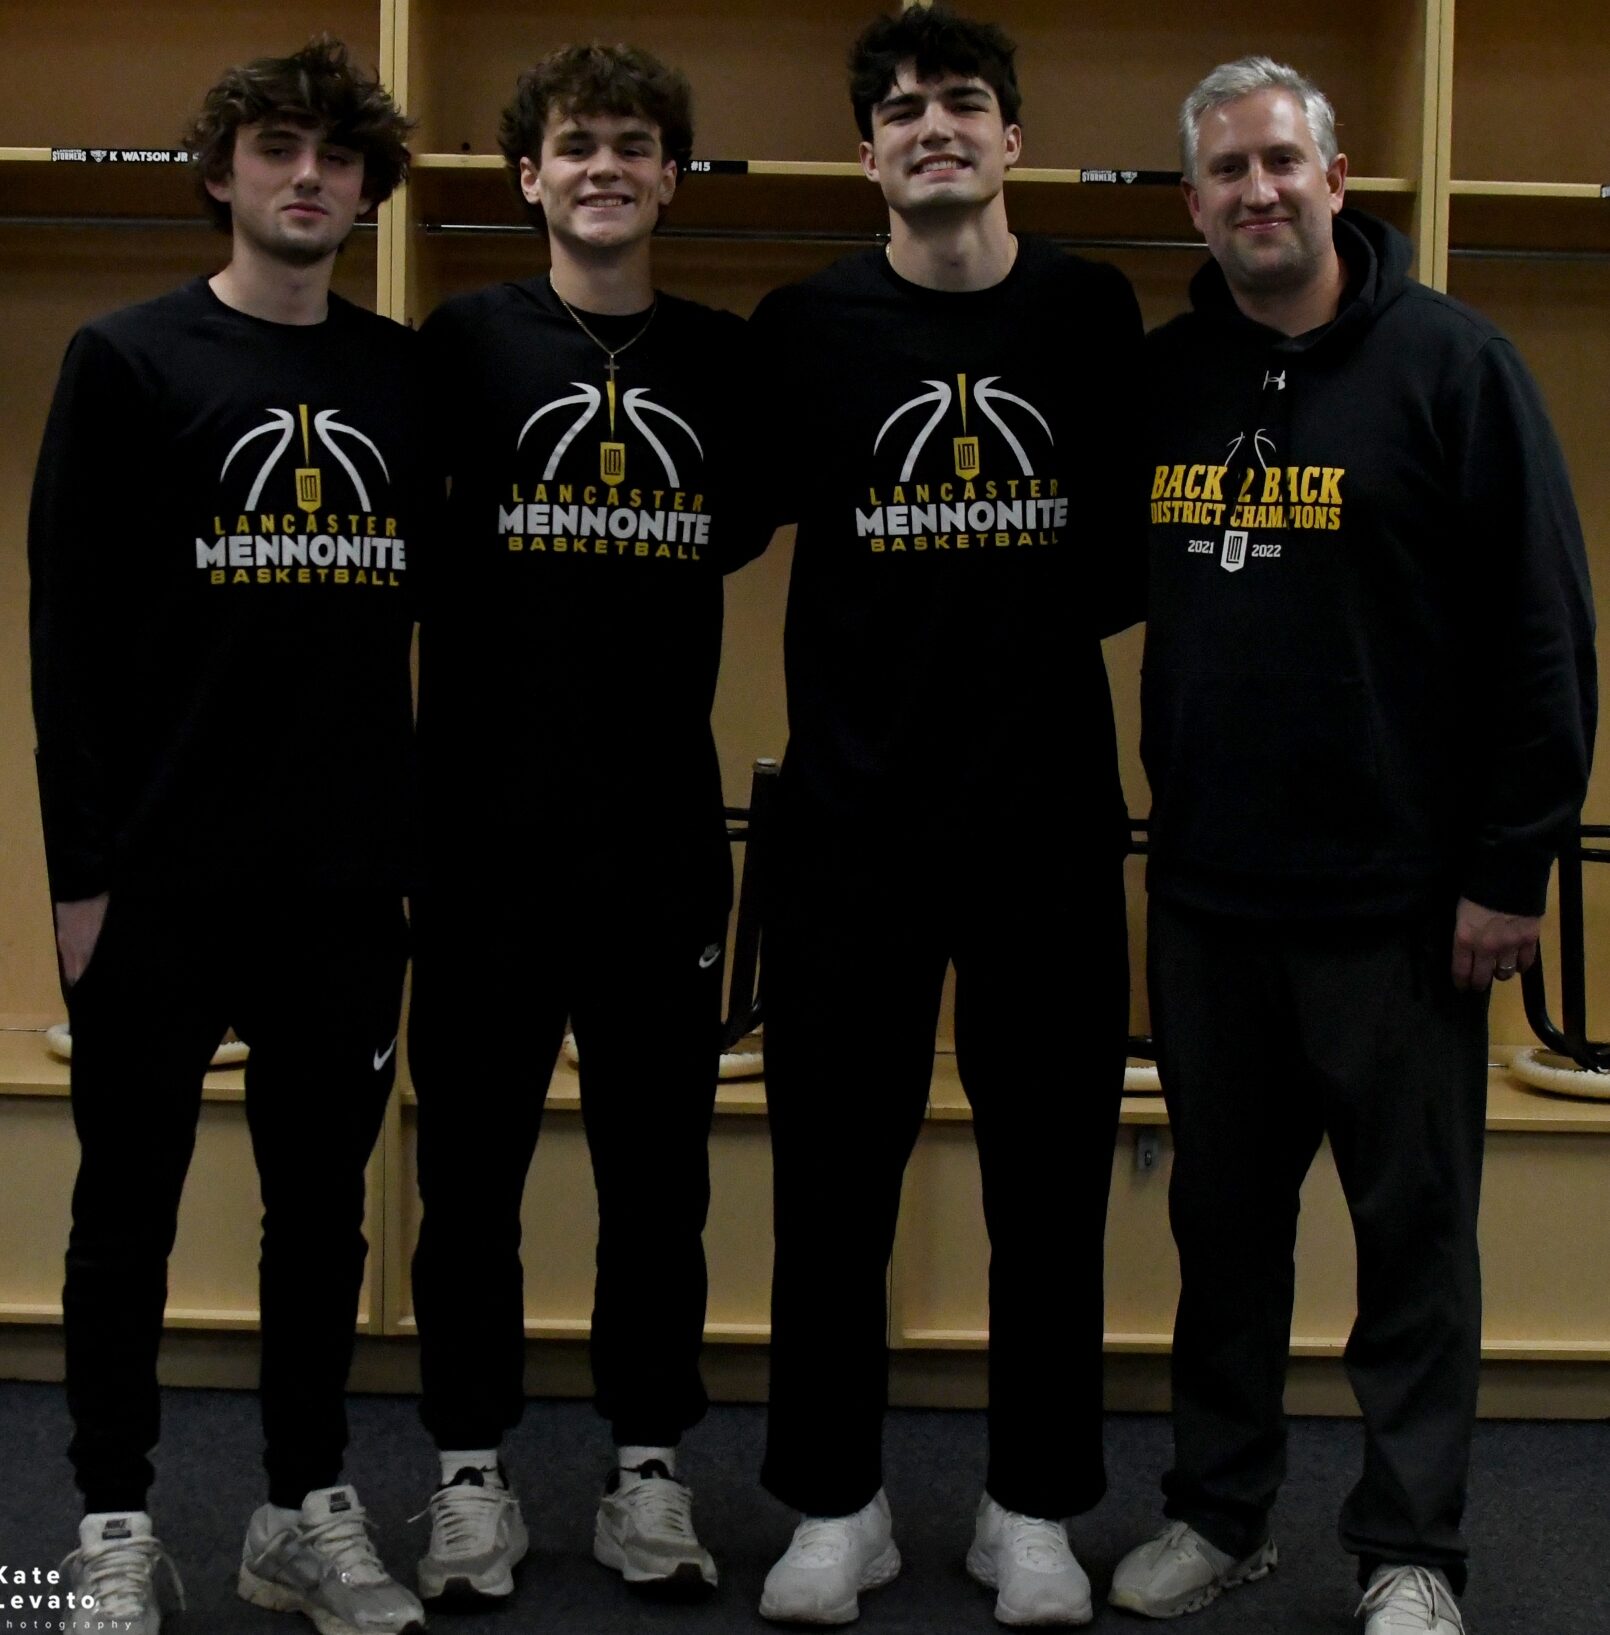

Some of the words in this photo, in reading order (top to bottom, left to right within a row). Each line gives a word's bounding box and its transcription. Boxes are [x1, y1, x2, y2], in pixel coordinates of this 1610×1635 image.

[109, 151, 118, 161] K
[121, 151, 170, 162] WATSON
[173, 151, 188, 162] JR
[691, 160, 711, 172] #15
[869, 479, 1058, 506] LANCASTER
[1151, 464, 1228, 500] BACK
[1238, 467, 1255, 503] 2
[1261, 466, 1345, 504] BACK
[511, 483, 704, 512] LANCASTER
[213, 513, 397, 537] LANCASTER
[498, 503, 712, 544] MENNONITE
[855, 497, 1069, 537] MENNONITE
[1151, 501, 1227, 526] DISTRICT
[195, 534, 407, 570] MENNONITE
[508, 536, 700, 560] BASKETBALL
[870, 531, 1059, 552] BASKETBALL
[1187, 539, 1214, 554] 2021
[1251, 544, 1282, 557] 2022
[210, 568, 400, 586] BASKETBALL
